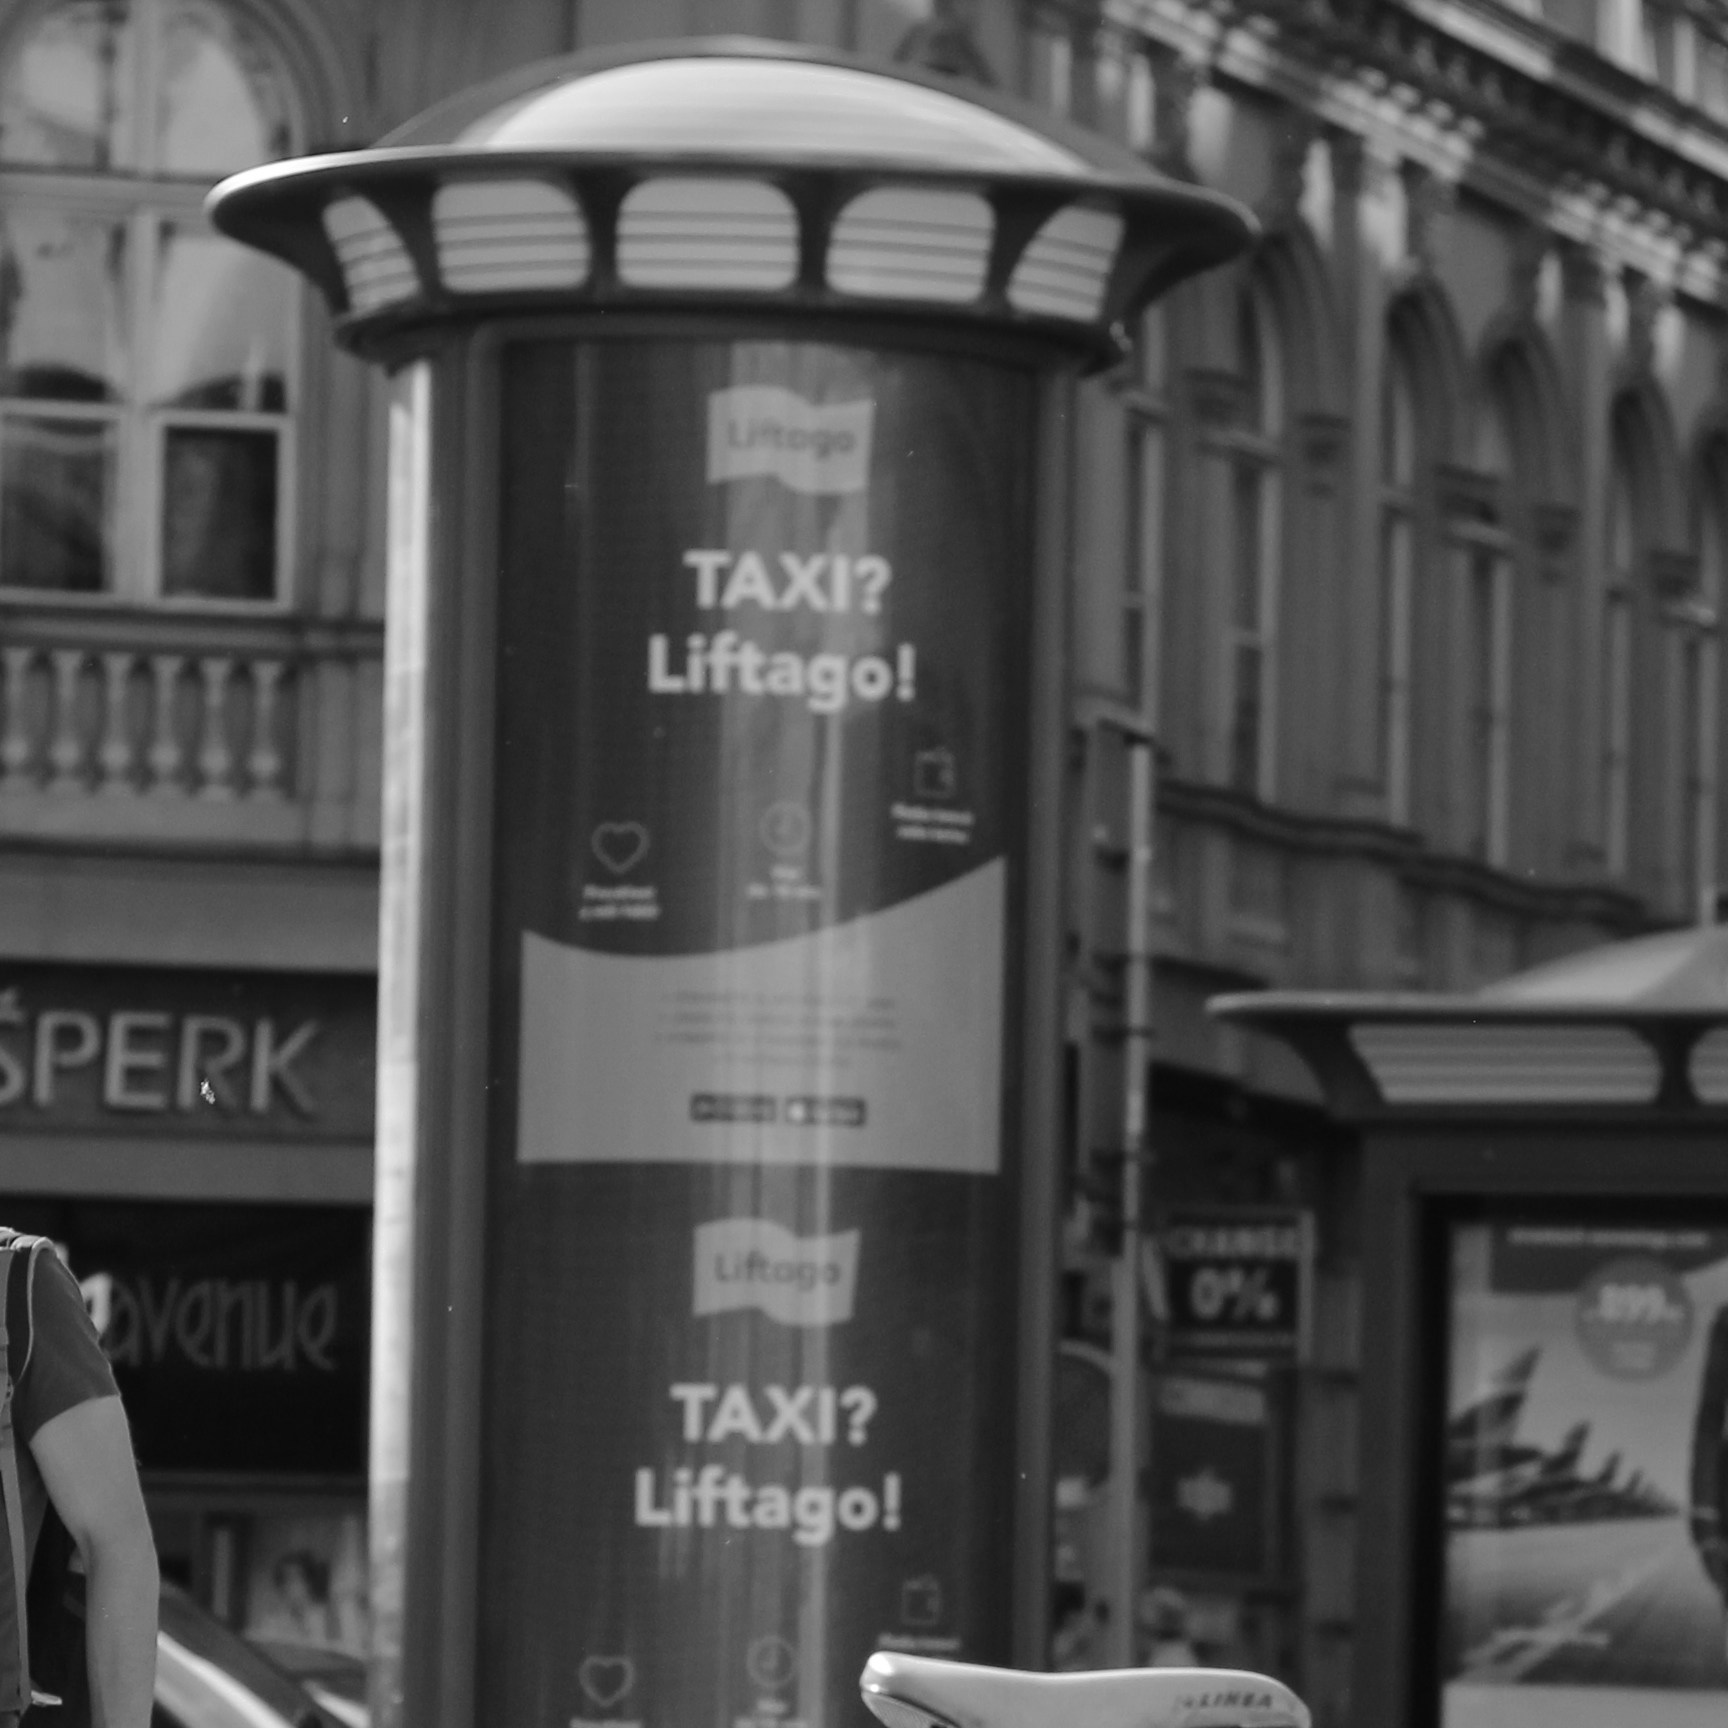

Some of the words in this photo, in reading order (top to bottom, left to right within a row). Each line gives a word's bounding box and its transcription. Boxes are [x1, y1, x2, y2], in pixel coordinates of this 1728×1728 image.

[726, 418, 858, 459] Liftago
[682, 547, 892, 615] TAXI?
[646, 630, 916, 714] Liftago!
[713, 1249, 841, 1292] Liftago
[1189, 1266, 1281, 1322] 0%
[668, 1381, 878, 1447] TAXI?
[633, 1465, 902, 1547] Liftago!
